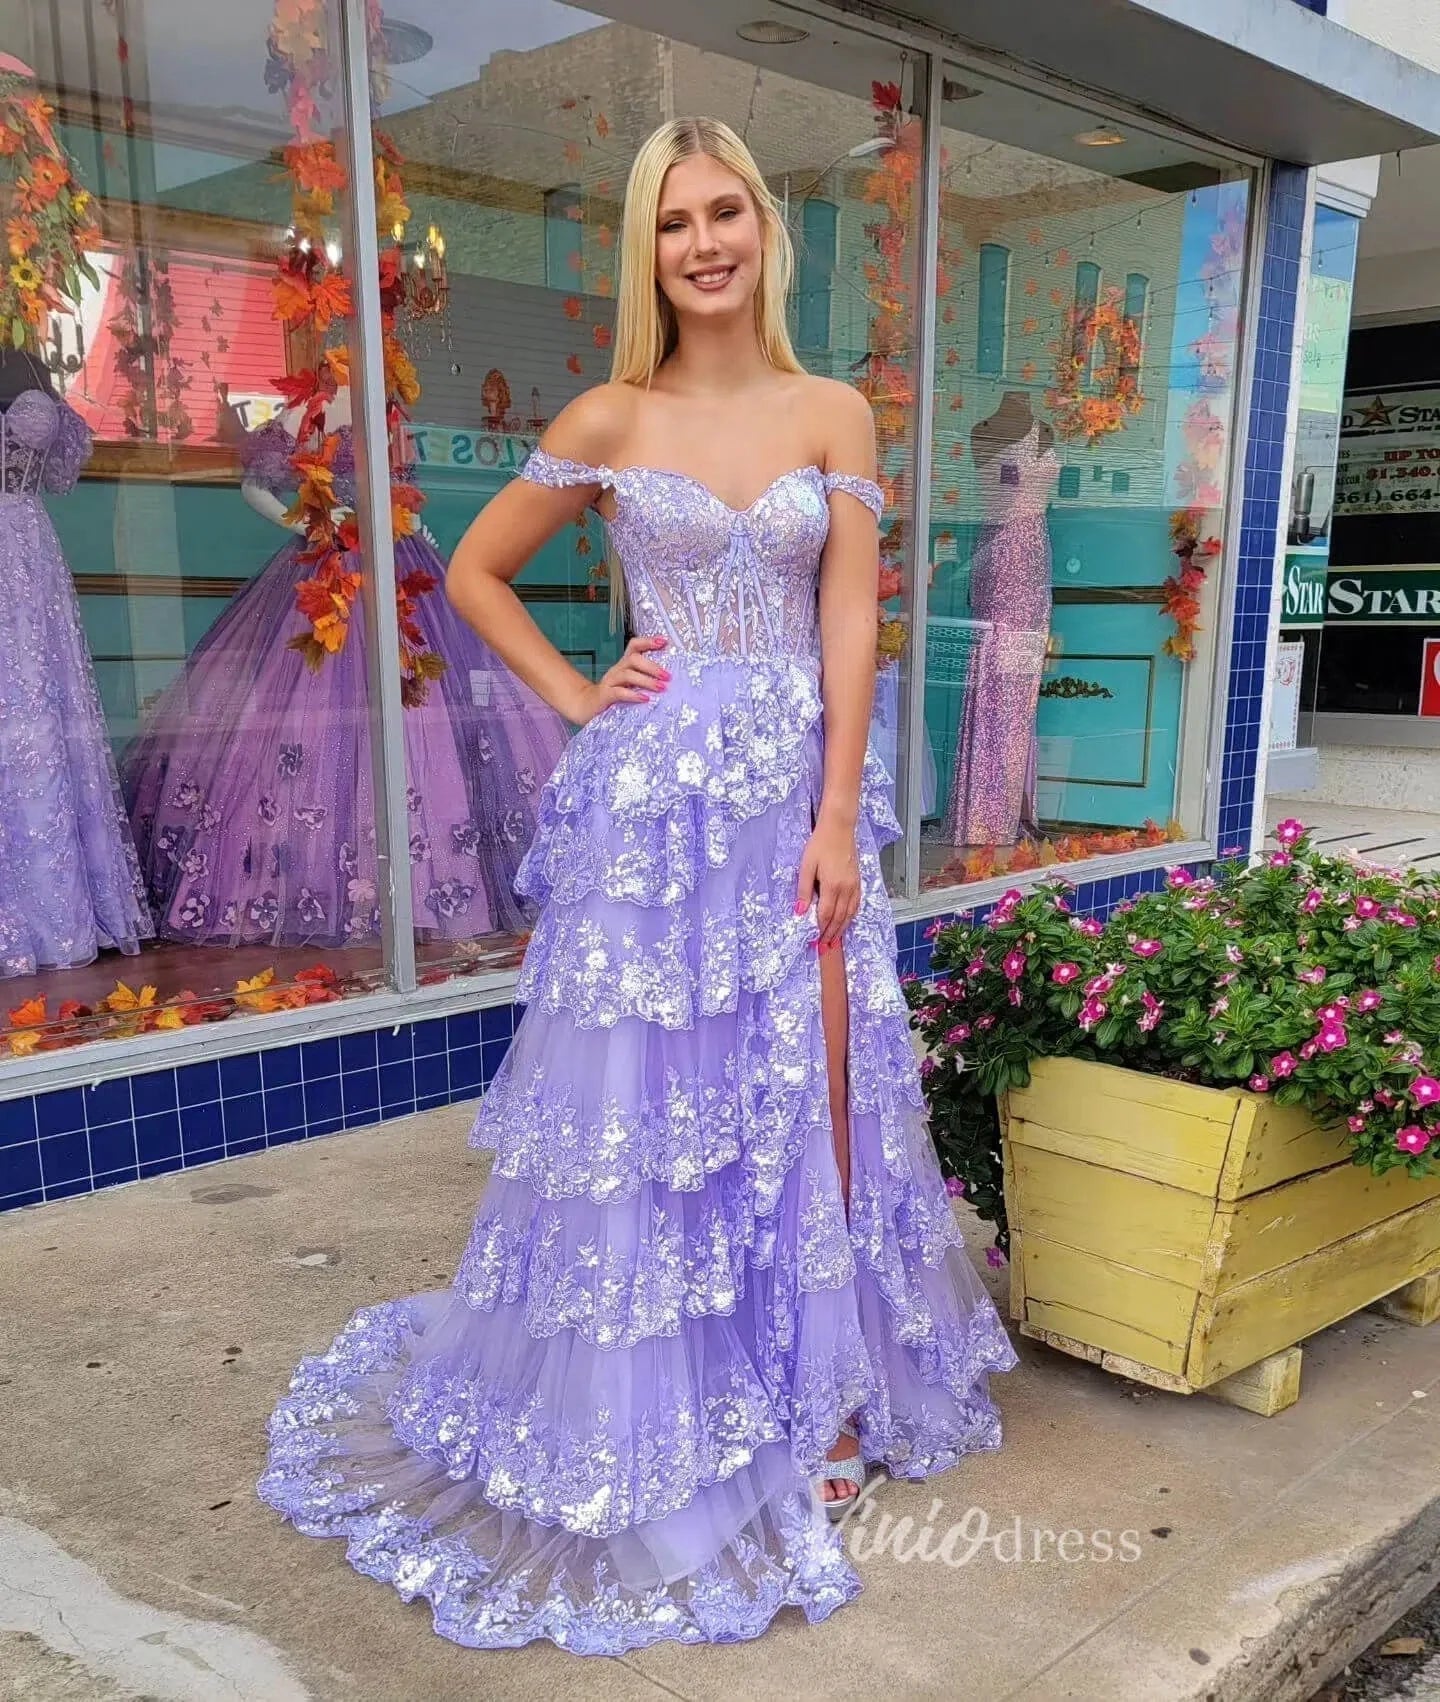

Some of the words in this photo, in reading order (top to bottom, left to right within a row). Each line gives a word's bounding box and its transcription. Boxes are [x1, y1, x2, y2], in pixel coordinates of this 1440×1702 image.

[1384, 450, 1412, 461] UP
[1286, 565, 1324, 616] STAR
[1328, 578, 1440, 615] STAR
